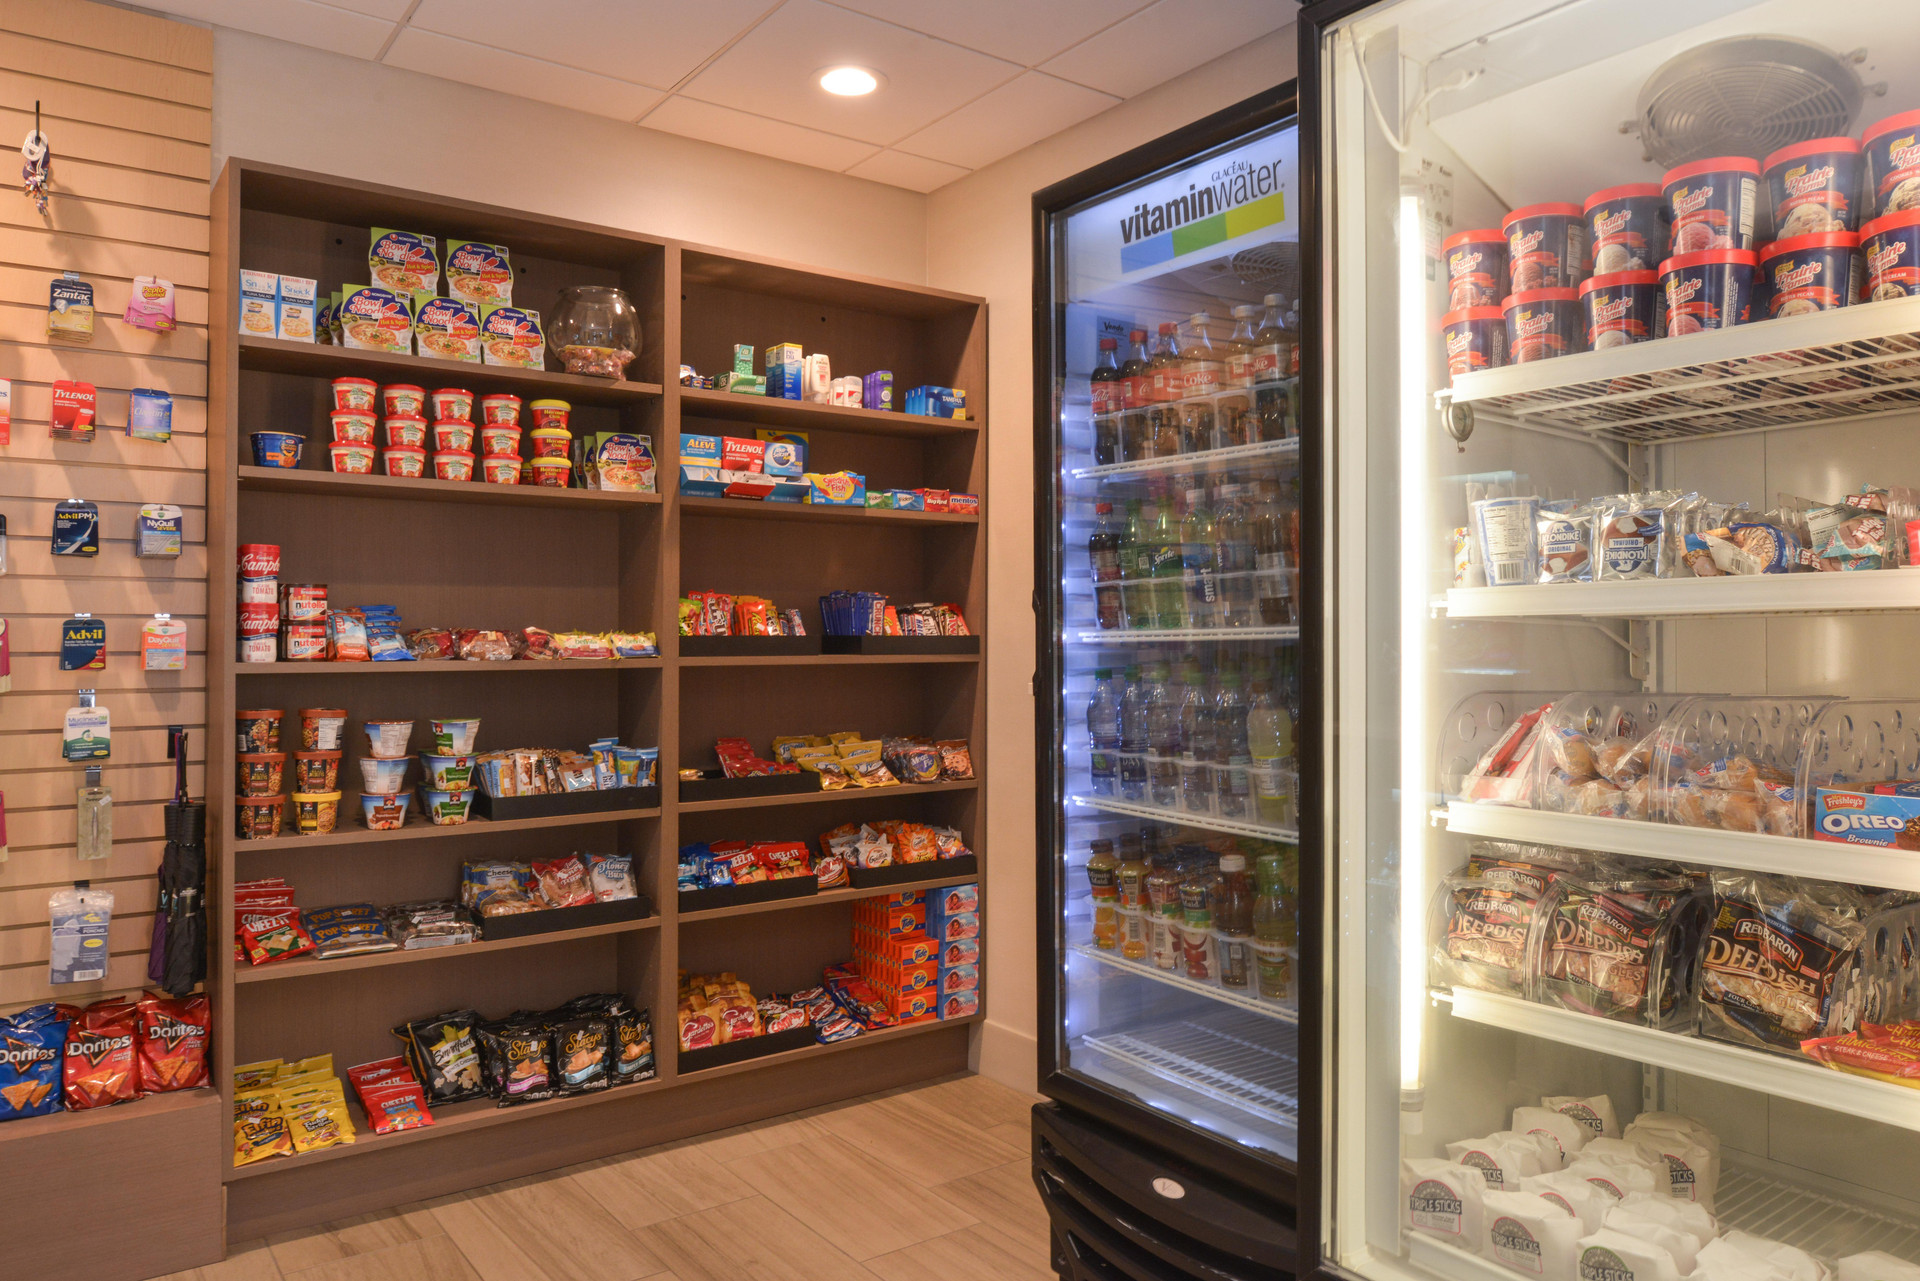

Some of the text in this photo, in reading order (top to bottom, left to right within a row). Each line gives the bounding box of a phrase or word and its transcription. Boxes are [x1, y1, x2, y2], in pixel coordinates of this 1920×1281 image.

[1211, 159, 1249, 182] GLACÉAU
[1785, 166, 1834, 190] Prairie
[1793, 180, 1827, 196] Farms
[1673, 186, 1713, 211] Prairie
[1679, 198, 1707, 217] Farms
[1594, 209, 1632, 233] Prairie
[1600, 221, 1626, 238] Farms
[381, 240, 410, 252] Bowl
[1511, 230, 1544, 252] Prairie
[456, 251, 485, 263] Bowl
[1868, 241, 1906, 268] Prairie
[1451, 252, 1483, 272] Prairie
[1775, 262, 1823, 287] Prairie
[1782, 275, 1815, 292] Farms
[53, 288, 91, 300] Zantac
[1666, 278, 1703, 303] Prairie
[352, 296, 384, 308] Bowl
[1595, 297, 1632, 319] Prairie
[425, 306, 454, 319] Bowl
[1600, 309, 1626, 324] Farms
[490, 315, 517, 328] Bowl
[1516, 313, 1554, 333] Prairie
[1522, 323, 1549, 338] Farms
[1184, 371, 1213, 387] Coke
[54, 389, 94, 401] TYLENOL
[942, 396, 963, 404] TAMPAX
[606, 442, 630, 453] Bowl
[687, 439, 716, 450] ALEVE
[725, 441, 763, 454] TYLENOL
[823, 476, 850, 488] Swedish
[831, 483, 846, 492] Fish
[951, 497, 978, 505] mentos
[147, 519, 174, 529] NyQuil
[1852, 518, 1885, 539] Fudge
[1541, 530, 1581, 543] KLONDIKE
[1870, 528, 1885, 541] Bar
[1547, 545, 1572, 553] ORIGINAL
[1612, 538, 1639, 547] ORIGINAL
[1154, 549, 1175, 565] Sprite
[1604, 547, 1648, 561] KLONDIKE
[252, 587, 274, 595] TOMATO
[1200, 568, 1215, 603] smart
[295, 600, 326, 609] nutella
[66, 629, 103, 640] Advil
[147, 636, 180, 645] DayQuil
[248, 645, 271, 653] TOMATO
[293, 638, 324, 647] nutella
[911, 754, 929, 766] Moon
[923, 758, 934, 768] Pie
[1826, 796, 1863, 807] Freshley's
[1822, 814, 1905, 834] OREO
[1846, 834, 1888, 847] Brownie
[487, 868, 513, 876] Cheese
[598, 860, 630, 874] Honey
[606, 869, 625, 879] Bun
[1486, 870, 1542, 890] RED BARON
[901, 891, 915, 902] Tide
[1468, 902, 1489, 912] RED
[901, 918, 915, 929] Tide
[1580, 904, 1631, 936] RED BARON
[1740, 921, 1799, 962] RED BARON
[914, 948, 928, 960] Tide
[1592, 954, 1642, 981] SINGLES
[913, 974, 927, 986] Tide
[1752, 979, 1815, 1015] SINGLES
[911, 1001, 926, 1014] Tide
[150, 1025, 205, 1040] Doritos
[69, 1035, 131, 1057] Doritos
[1834, 1045, 1856, 1056] STEAK
[1862, 1051, 1889, 1061] CHEESE
[1411, 1199, 1461, 1213] TRIPLE STICKS
[1513, 1237, 1540, 1254] STICKS
